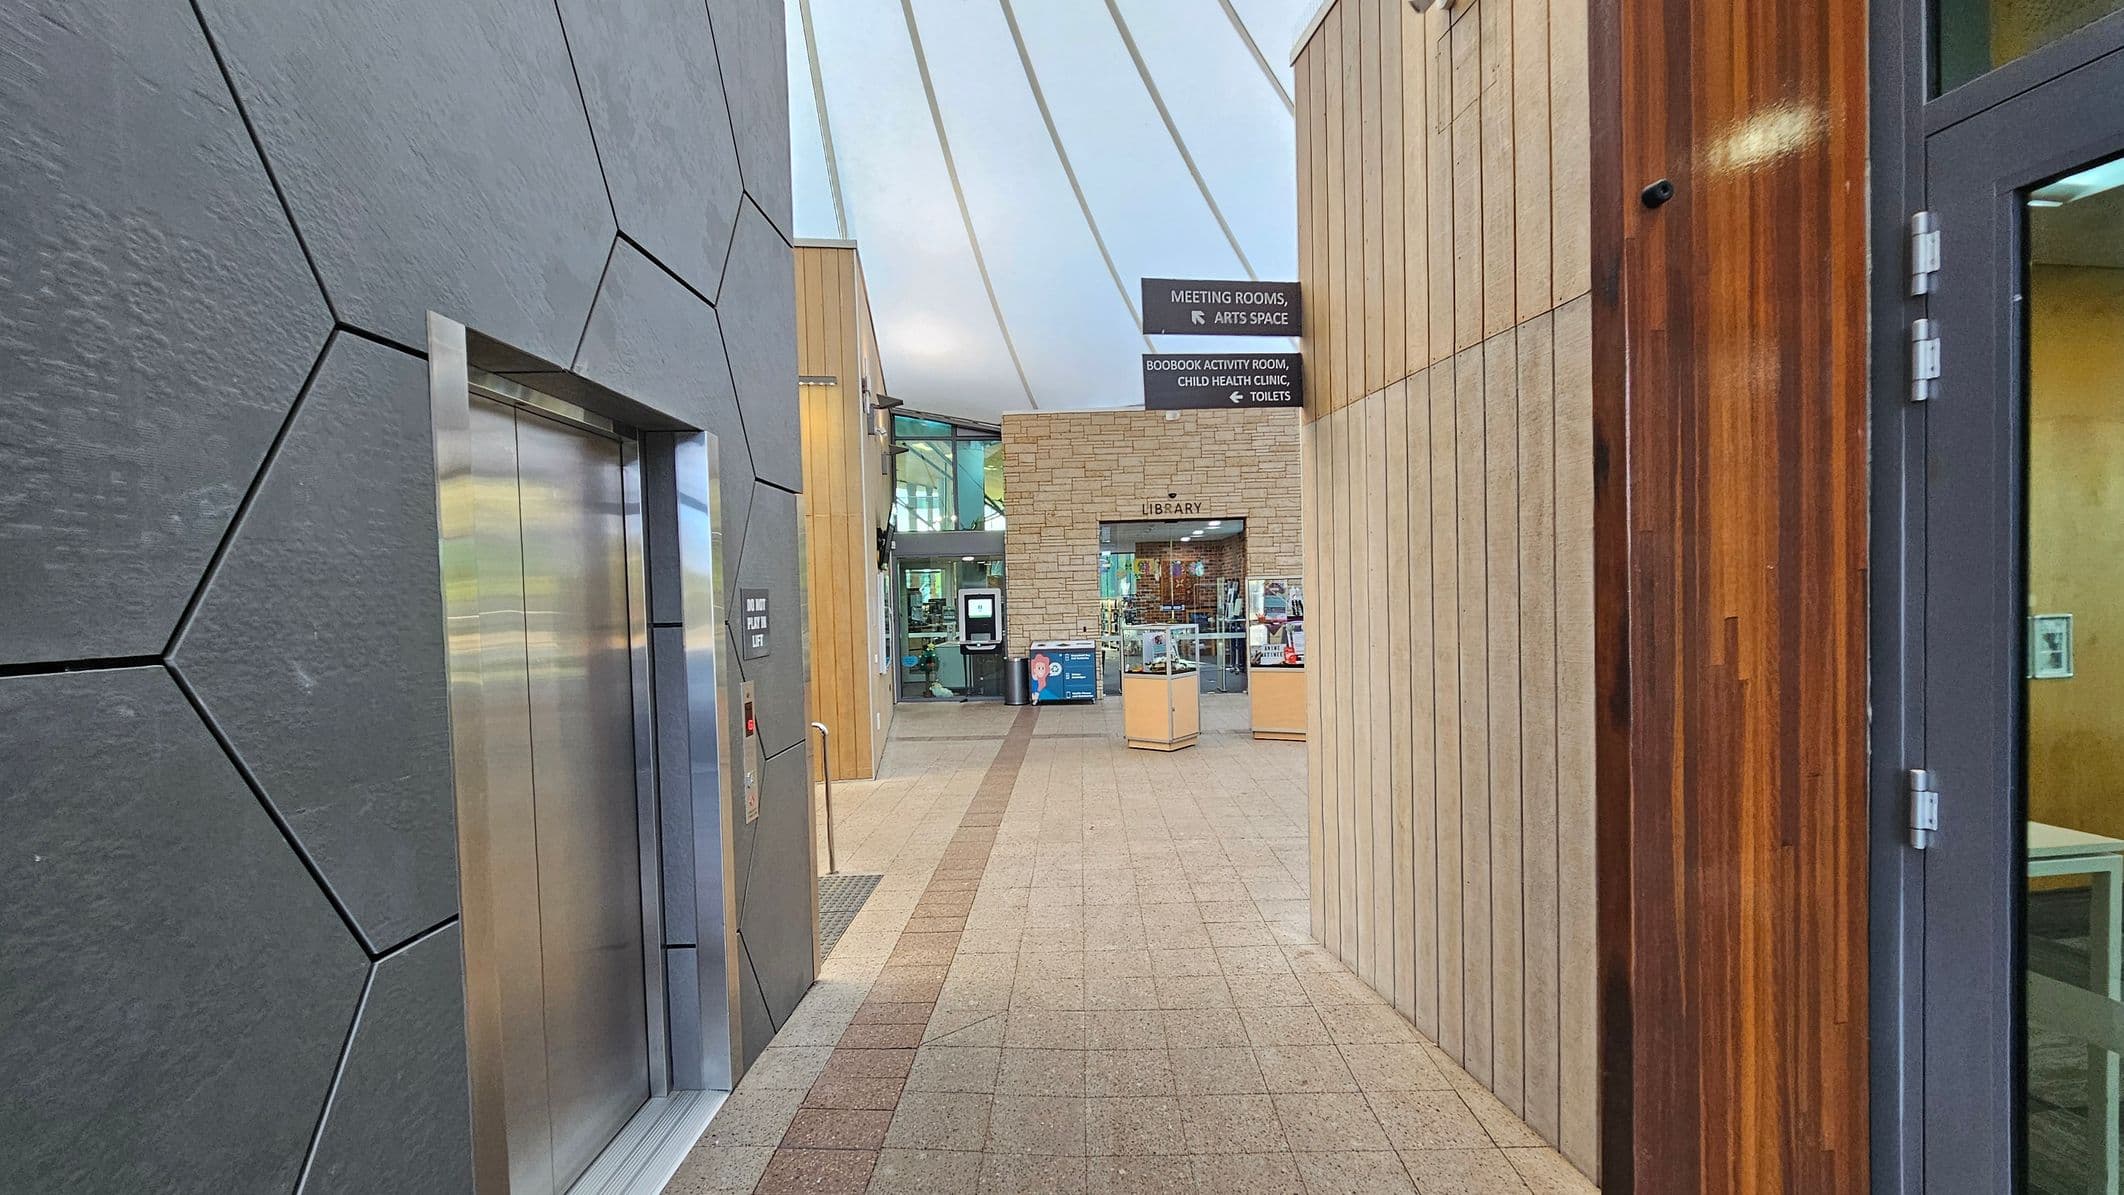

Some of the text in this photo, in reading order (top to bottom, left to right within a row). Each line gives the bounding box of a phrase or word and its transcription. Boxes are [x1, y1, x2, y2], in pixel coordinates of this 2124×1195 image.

[1171, 290, 1288, 307] MEETING ROOMS,
[1214, 312, 1289, 325] ARTS SPACE
[1146, 359, 1289, 371] BOOBOOK ACTIVITY ROOM,
[1177, 375, 1290, 387] CHILD HEALTH CLINIC,
[1250, 391, 1291, 402] TOILETS
[1142, 502, 1202, 515] LIBRARY
